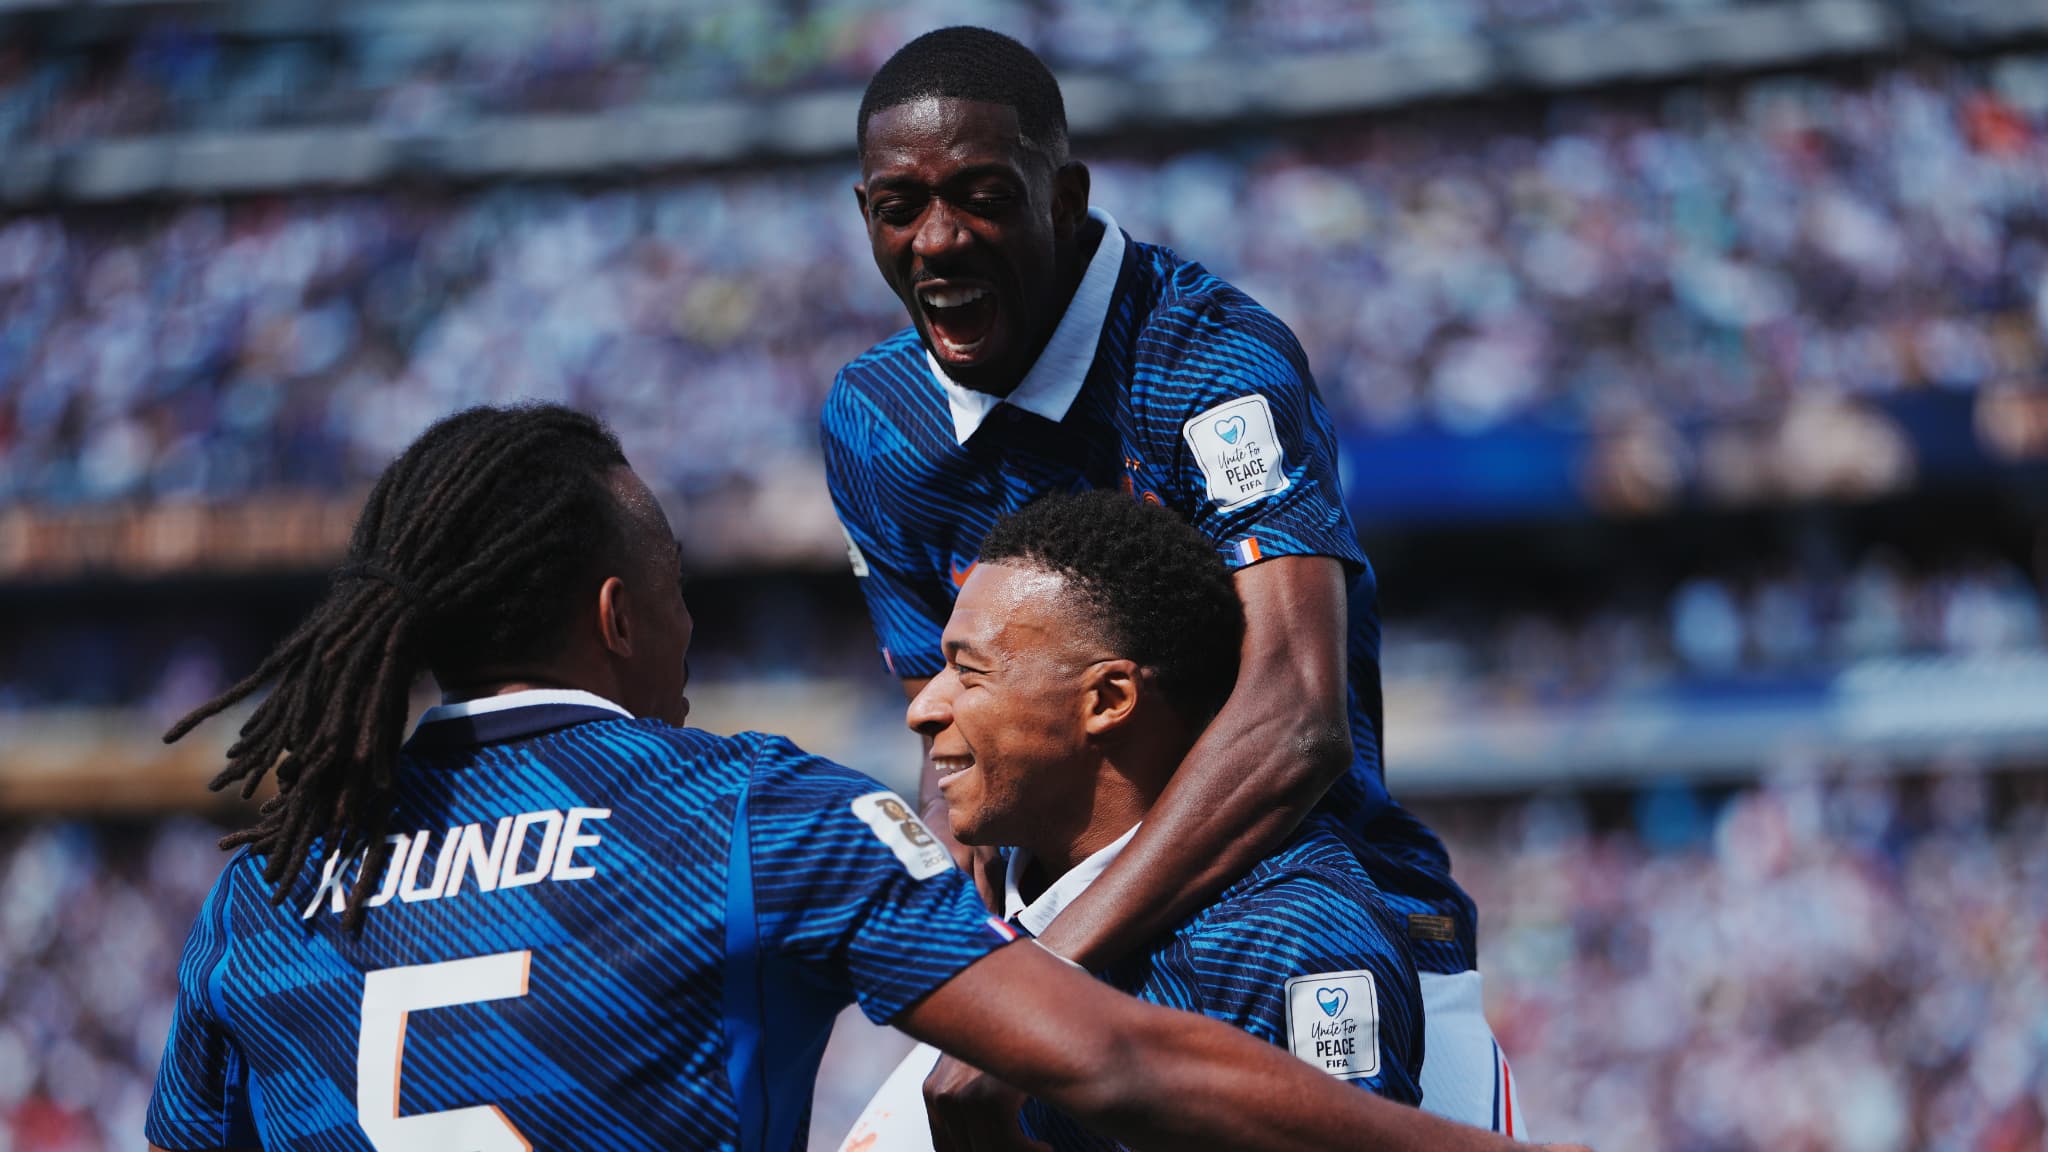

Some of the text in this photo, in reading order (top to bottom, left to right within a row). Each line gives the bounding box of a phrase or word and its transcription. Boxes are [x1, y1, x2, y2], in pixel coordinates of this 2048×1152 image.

[1218, 441, 1260, 469] Unite For
[1225, 458, 1267, 485] PEACE
[1239, 479, 1262, 493] FIFA
[1312, 1018, 1358, 1039] Unite For
[357, 950, 533, 1152] 5
[1316, 1038, 1355, 1057] PEACE
[1326, 1059, 1349, 1068] FIFA
